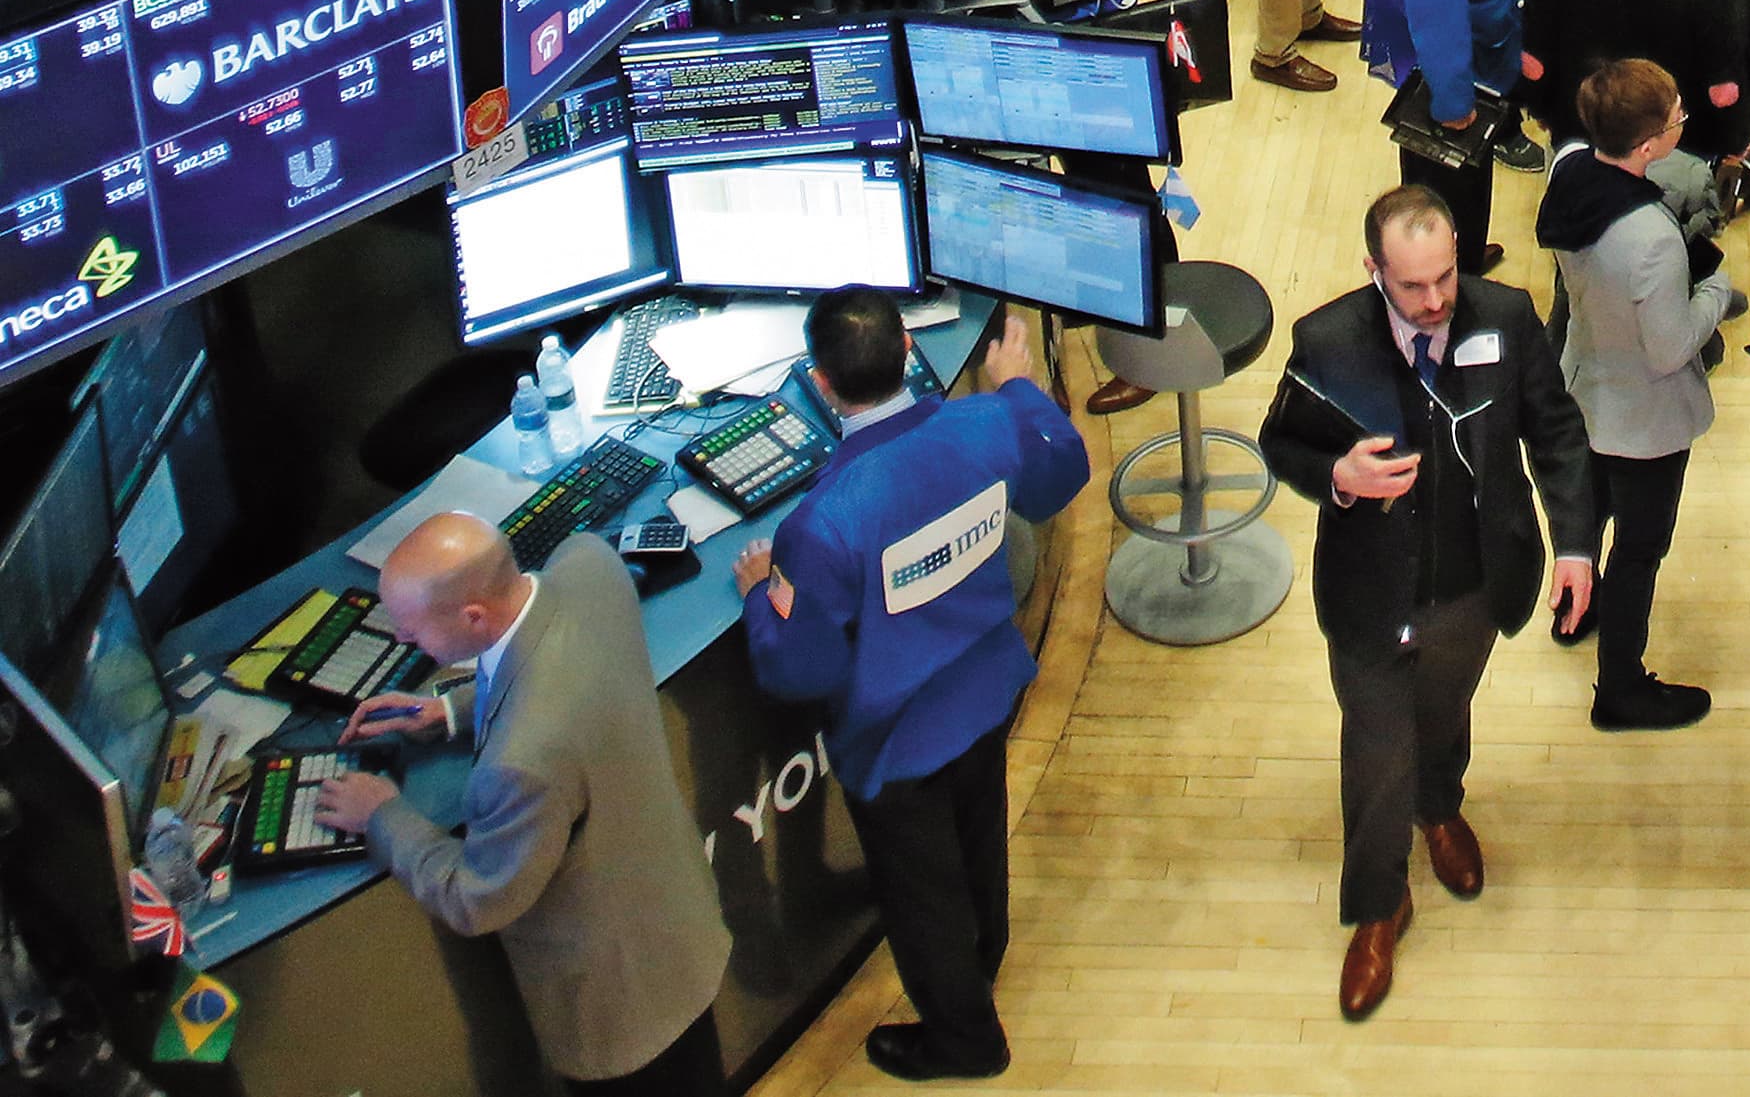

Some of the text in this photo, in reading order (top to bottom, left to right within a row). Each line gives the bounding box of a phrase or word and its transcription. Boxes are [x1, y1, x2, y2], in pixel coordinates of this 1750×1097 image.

[77, 8, 118, 33] 39.32
[150, 0, 207, 30] 629,891
[81, 33, 121, 58] 39.19
[410, 25, 444, 49] 52.74
[338, 56, 373, 80] 52.71
[412, 48, 446, 71] 52.64
[340, 79, 375, 102] 52.77
[266, 111, 301, 135] 52.66
[155, 141, 181, 160] UL
[174, 143, 228, 176] 102,151
[463, 133, 516, 180] 2425
[106, 180, 145, 205] 33.66
[288, 177, 343, 208] Unilever
[17, 193, 59, 218] 33.71
[21, 217, 62, 243] 33.73
[956, 509, 1001, 559] imc
[734, 730, 829, 843] YO
